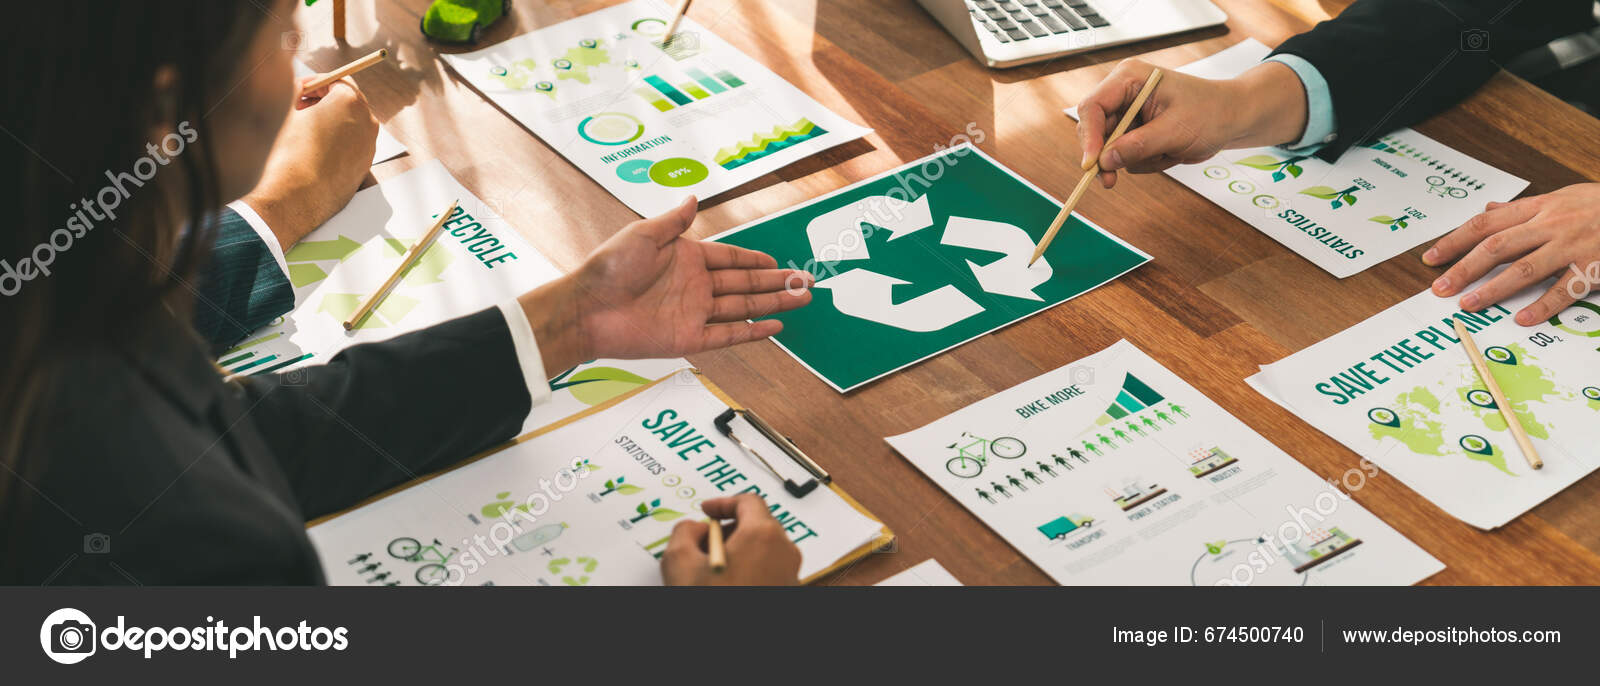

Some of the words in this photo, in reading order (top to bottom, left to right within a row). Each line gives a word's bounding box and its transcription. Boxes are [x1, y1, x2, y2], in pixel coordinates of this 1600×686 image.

[600, 134, 673, 164] INFORMATION
[1352, 177, 1376, 191] 2022
[1403, 206, 1428, 220] 2021
[1277, 209, 1364, 259] STATISTICS
[1315, 361, 1391, 405] SAVE
[1369, 338, 1435, 374] THE
[1016, 399, 1050, 419] BIKE
[1045, 383, 1086, 406] MORE
[614, 435, 666, 476] STATISTICS
[641, 409, 716, 461] SAVE
[696, 454, 748, 492] THE
